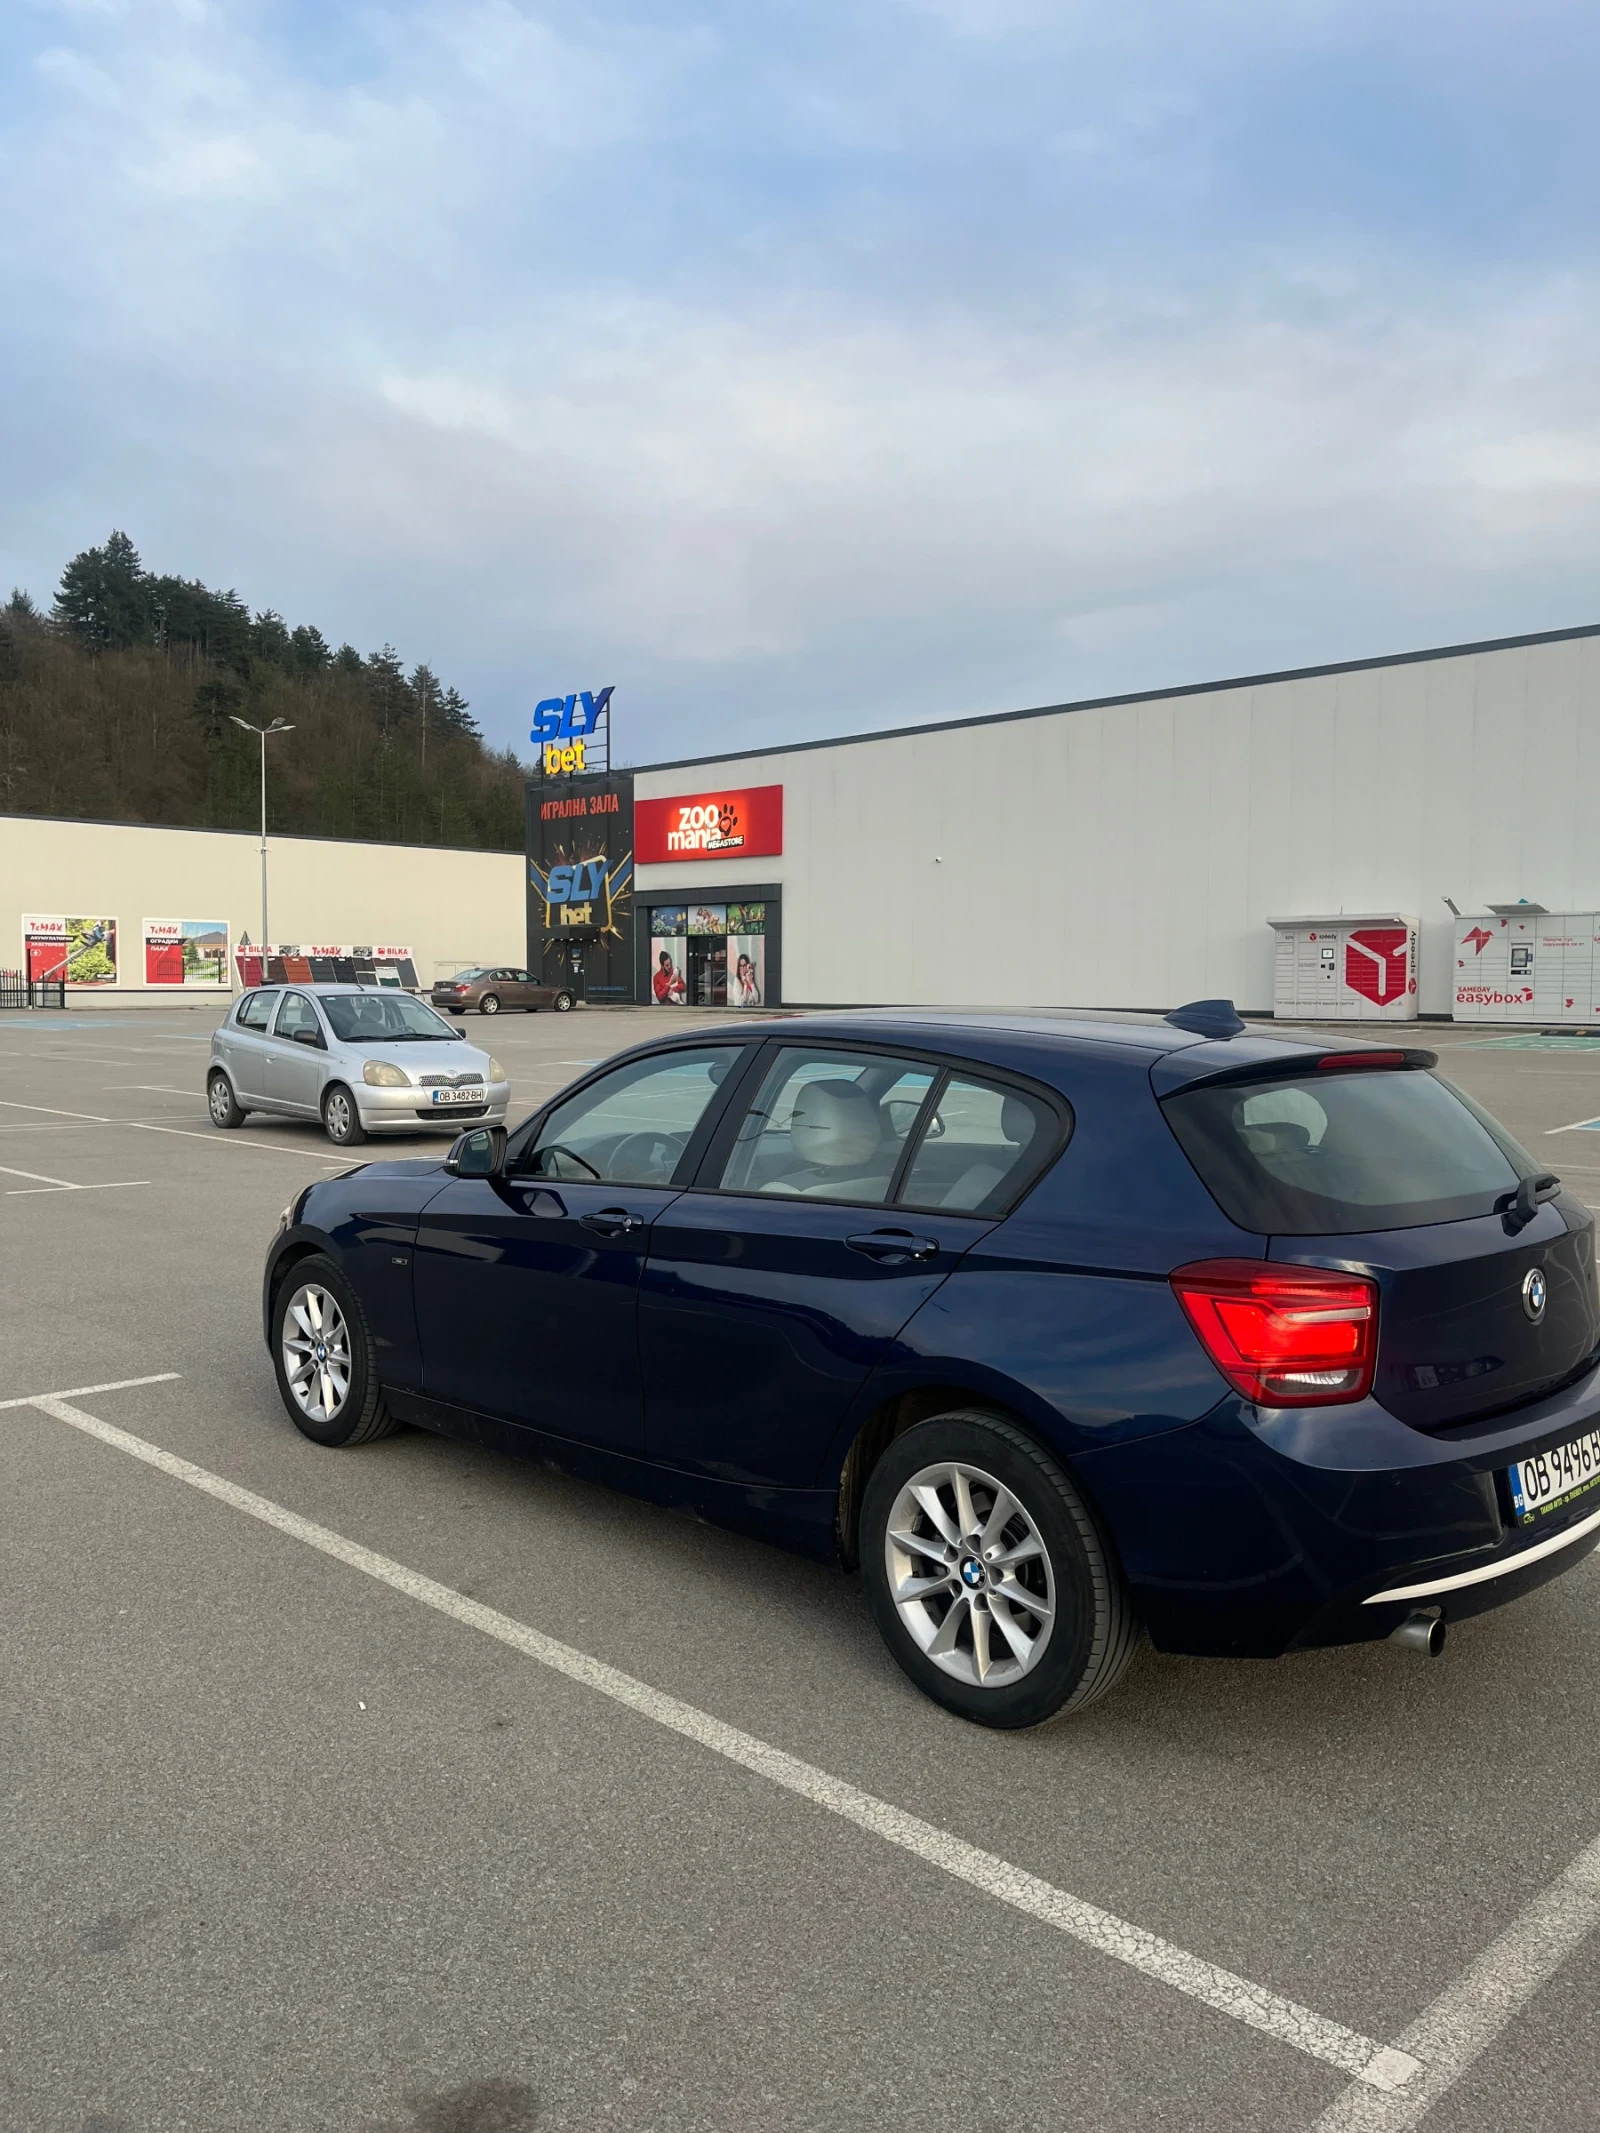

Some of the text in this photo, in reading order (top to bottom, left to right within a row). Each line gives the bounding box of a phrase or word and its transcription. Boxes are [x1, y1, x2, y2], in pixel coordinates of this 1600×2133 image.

[530, 686, 615, 743] SLY
[545, 738, 586, 775] bet
[541, 793, 619, 820] ИГРАЛНА ЗАЛА
[667, 828, 722, 851] mania
[707, 836, 744, 850] MEGASTORE
[546, 859, 614, 904] SLY
[560, 901, 592, 926] bet
[386, 947, 408, 955] BILKA
[1456, 991, 1523, 1006] easybox
[440, 1092, 450, 1101] OB
[452, 1091, 470, 1100] 3482
[471, 1090, 482, 1100] BH
[1524, 1456, 1550, 1501] OB
[1551, 1436, 1591, 1488] 9496
[1513, 1494, 1523, 1508] BG
